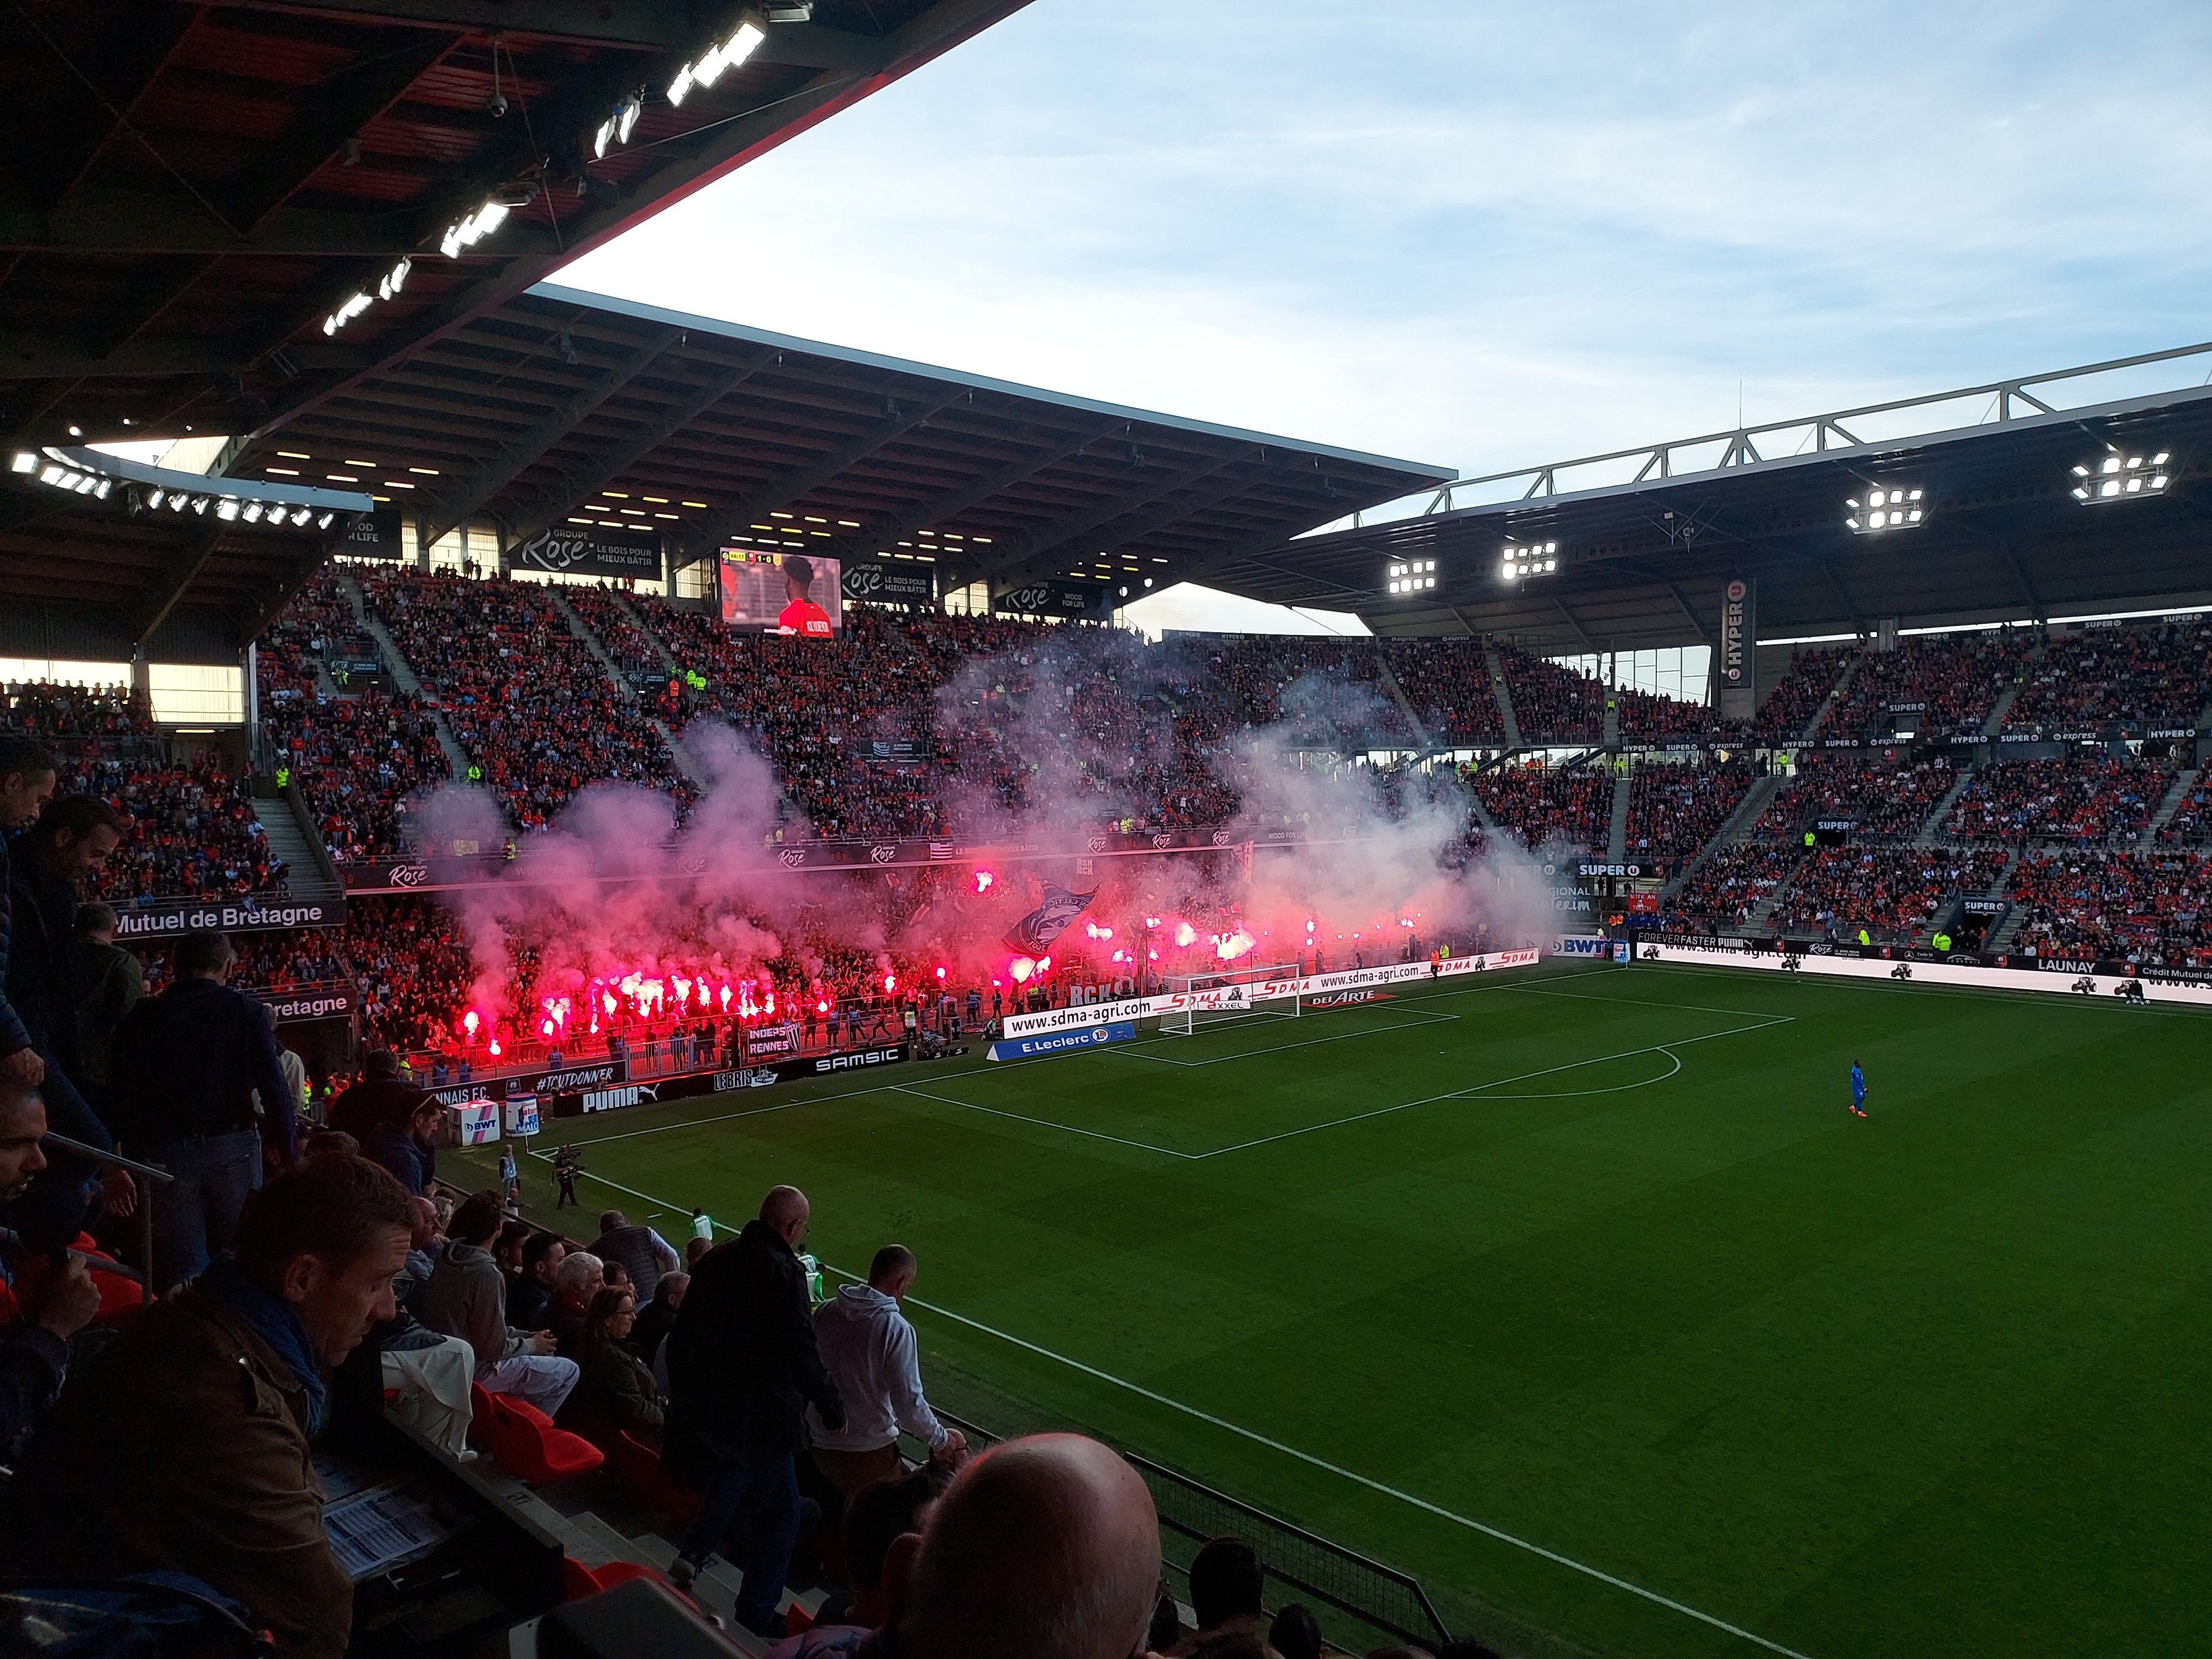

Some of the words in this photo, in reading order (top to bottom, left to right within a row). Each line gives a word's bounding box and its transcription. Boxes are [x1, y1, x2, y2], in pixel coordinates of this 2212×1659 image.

[357, 533, 379, 542] LIFE
[553, 529, 589, 540] GROUPE
[522, 527, 589, 571] Rose
[597, 545, 607, 554] LE
[609, 546, 628, 555] BOIS
[629, 548, 653, 557] POUR
[597, 554, 627, 564] MIEUX
[627, 556, 653, 566] BÂTIR
[885, 575, 892, 583] LE
[893, 576, 908, 585] BOIS
[909, 578, 926, 586] POUR
[885, 584, 907, 592] MIEUX
[1728, 602, 1743, 665] HYPER
[1889, 703, 1917, 712] SUPER
[1950, 735, 1979, 744] HYPER
[2063, 732, 2097, 742] express
[2151, 730, 2185, 738] HYPER
[1818, 821, 1849, 830] SUPER
[1086, 836, 1107, 854] Rose
[1152, 833, 1171, 850] Rose
[1212, 831, 1230, 847] Rose
[778, 849, 806, 869] Rose
[870, 846, 896, 865] Rose
[388, 864, 429, 889] Rose
[1580, 865, 1625, 876] SUPER
[1965, 901, 1996, 911] SUPER
[118, 910, 185, 934] Mutuel
[190, 910, 217, 928] de
[223, 906, 322, 927] Bretagne
[1564, 939, 1604, 953] BWT
[1718, 937, 1744, 948] PUMA
[1809, 943, 1833, 955] Rose
[2038, 958, 2096, 973] LAUNAY
[1321, 967, 1418, 988] www.sdma-agri.com
[2142, 967, 2169, 977] Crédit
[2171, 969, 2202, 979] Mutuel
[1012, 1001, 1150, 1032] www.sdma-agri.com
[750, 1029, 786, 1040] INDEPS
[750, 1041, 789, 1054] RENNES
[816, 1048, 899, 1072] SAMSIC
[714, 1074, 726, 1091] LE
[727, 1070, 753, 1089] BRIS
[472, 1086, 490, 1101] F.C.
[583, 1088, 639, 1114] PUMA
[474, 1119, 496, 1130] BWT
